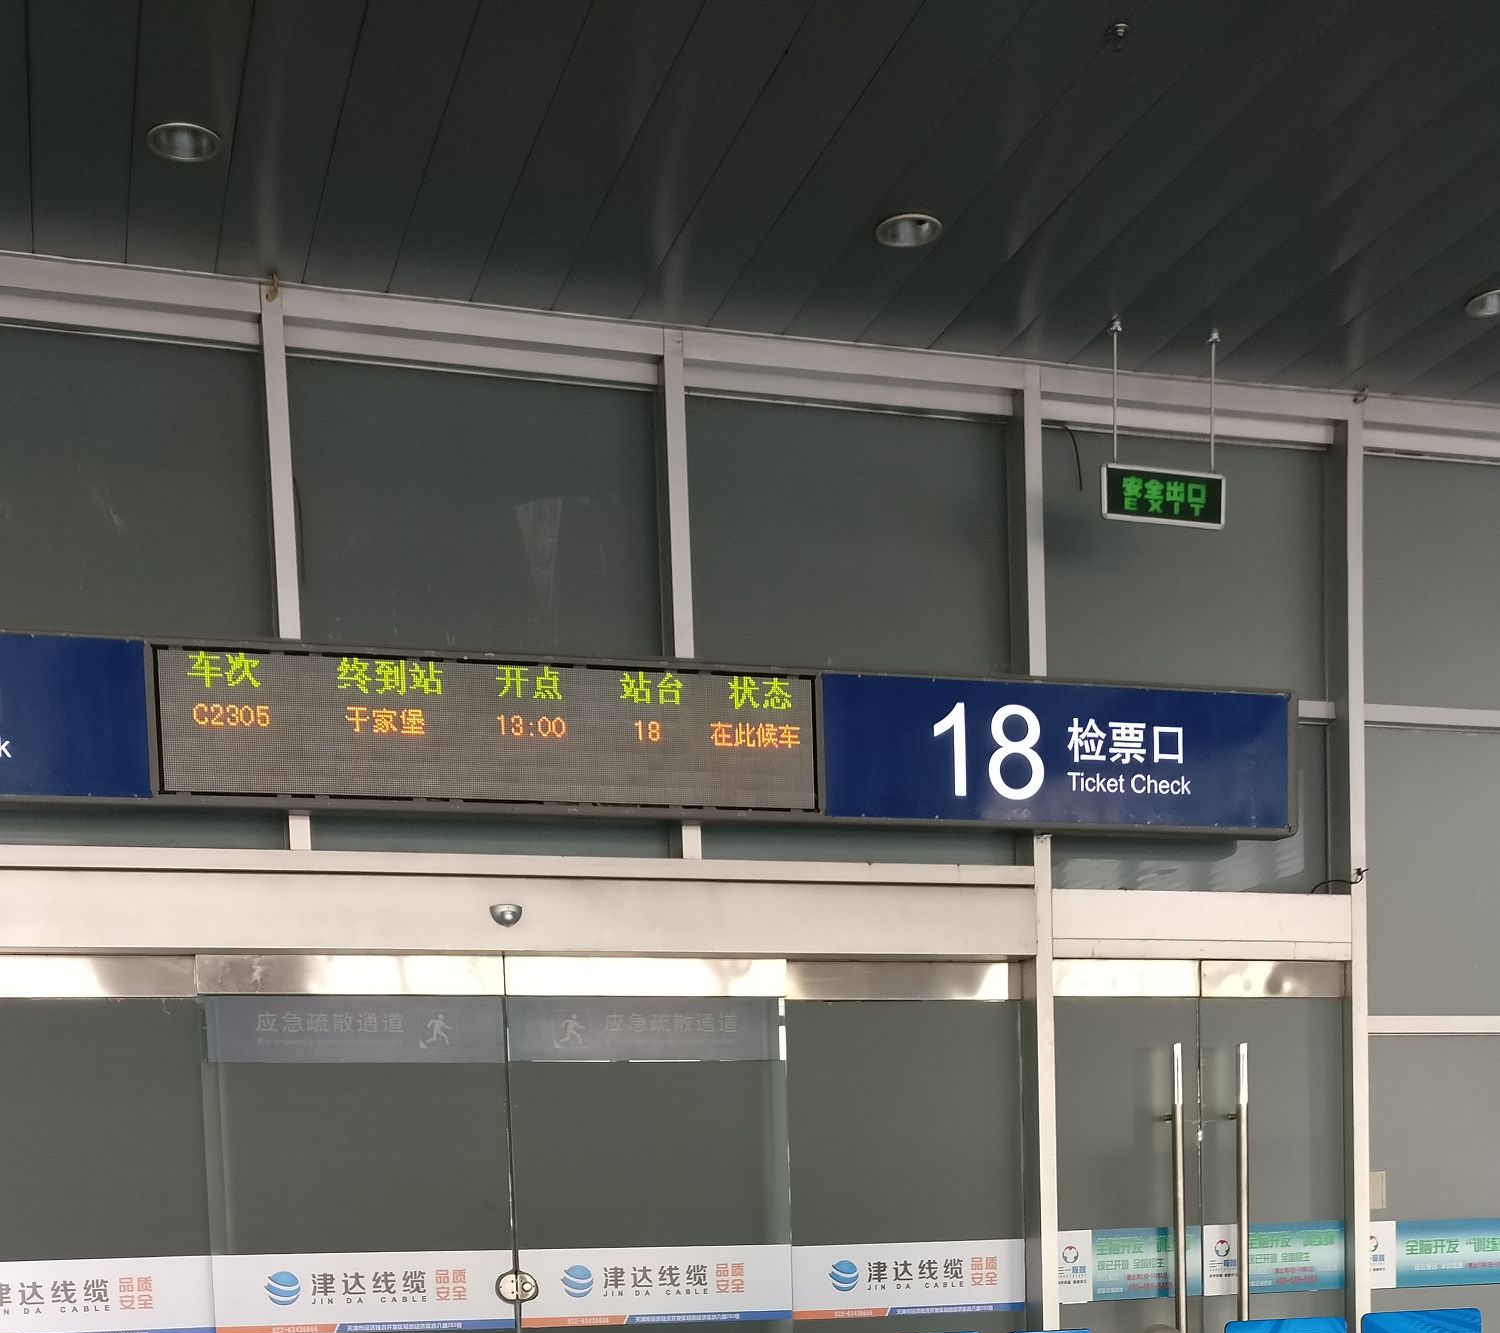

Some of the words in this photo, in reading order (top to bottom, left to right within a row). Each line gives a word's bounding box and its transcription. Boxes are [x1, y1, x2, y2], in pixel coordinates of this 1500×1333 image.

[1122, 476, 1206, 503] 安全出口
[1124, 498, 1205, 517] EXIT
[187, 651, 261, 688] 车次
[337, 657, 443, 695] 终到站
[496, 665, 562, 699] 开点
[620, 671, 683, 704] 站台
[728, 675, 792, 710] 状态
[192, 703, 271, 728] C2305
[345, 705, 425, 735] 于家堡
[496, 714, 566, 738] 13:00
[634, 720, 660, 741] 18
[710, 720, 801, 749] 在此候车
[1067, 717, 1185, 765] 检票口
[933, 701, 1045, 800] 18
[1067, 772, 1125, 794] Ticket
[1130, 774, 1191, 797] Check
[256, 1011, 404, 1033] 应急疏散通道
[605, 1011, 738, 1033] 应急疏散通道
[1405, 1238, 1460, 1256] 全脑开发
[716, 1263, 744, 1277] 品质
[867, 1259, 963, 1283] 津达线缆
[971, 1256, 998, 1270] 品质
[119, 1276, 152, 1292] 品质
[311, 1270, 427, 1296] 津达线缆
[435, 1269, 467, 1284] 品质
[603, 1265, 707, 1289] 津达线缆
[924, 1281, 964, 1289] CABLE
[971, 1272, 998, 1286] 安全
[435, 1286, 468, 1301] 安全
[666, 1288, 708, 1296] CABLE
[716, 1279, 745, 1293] 安全
[60, 1304, 110, 1313] CABLE
[120, 1295, 153, 1310] 安全
[311, 1296, 334, 1304] JIN
[380, 1295, 427, 1303] CABLE
